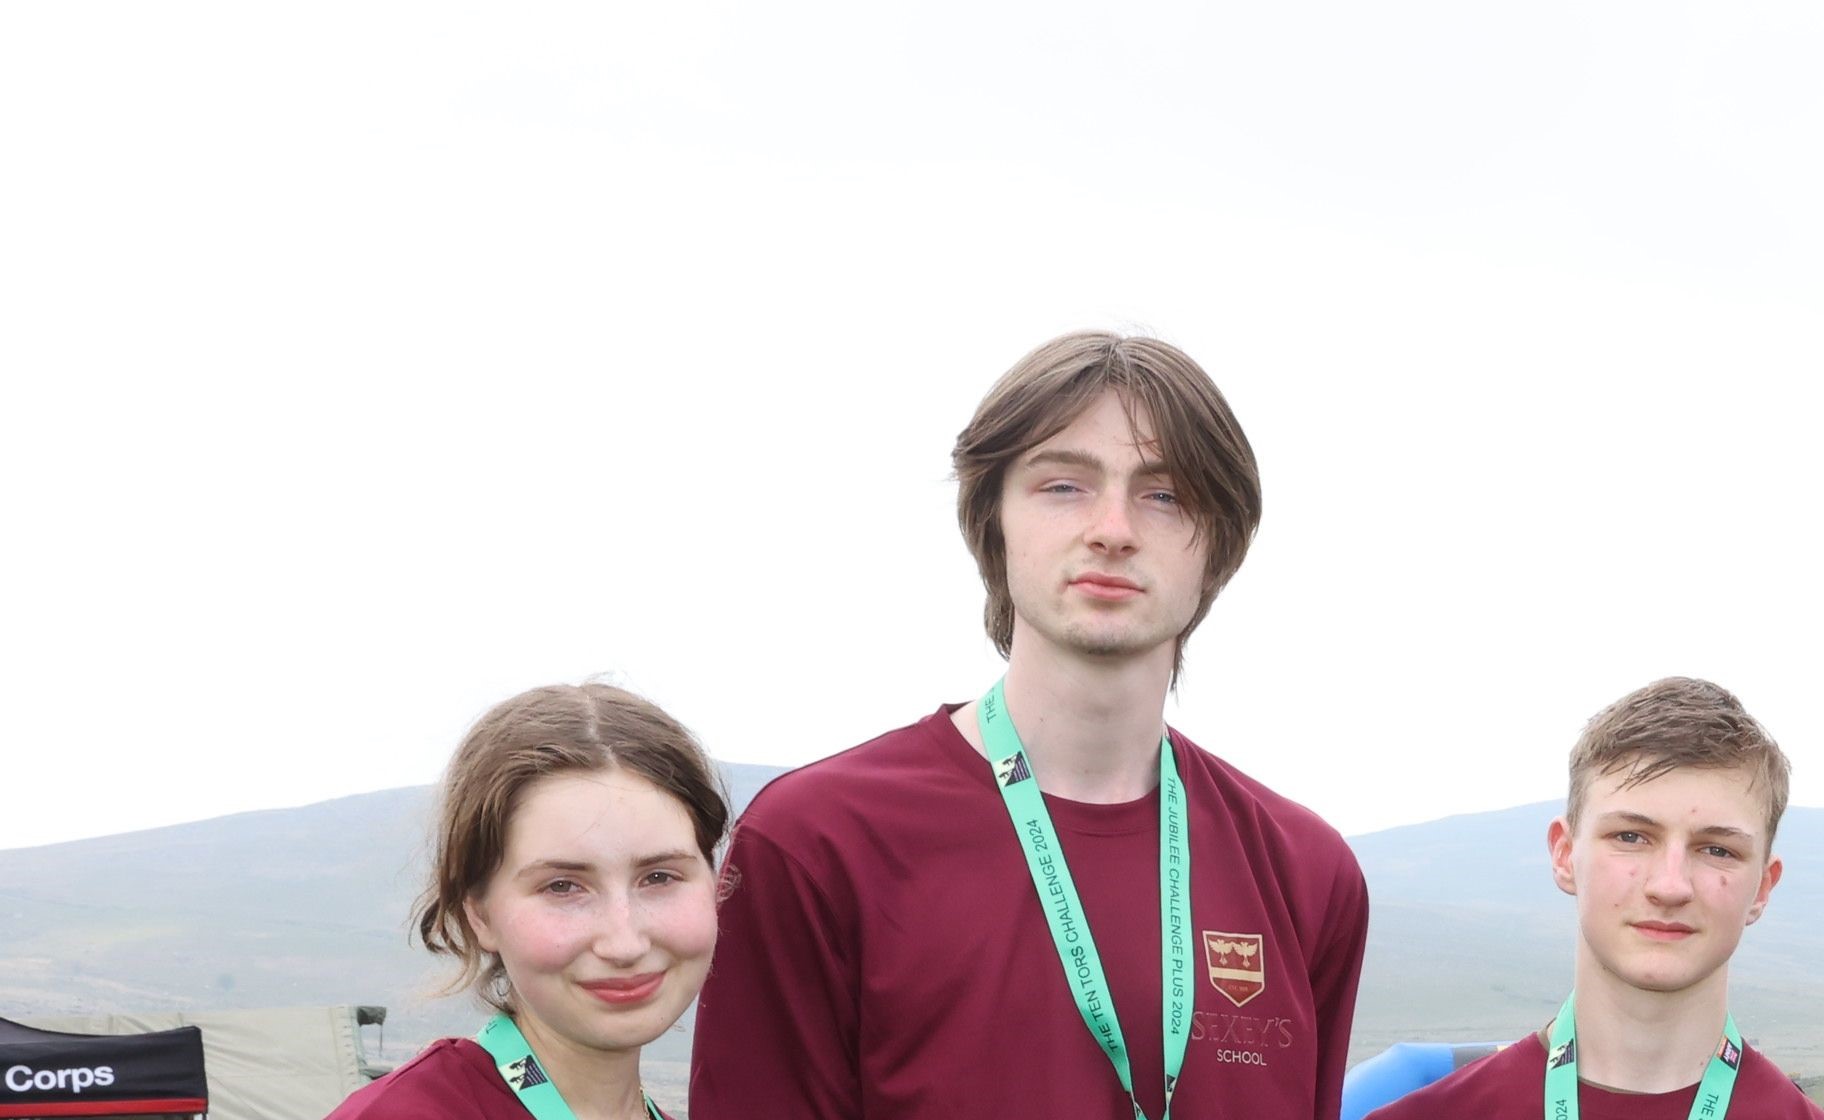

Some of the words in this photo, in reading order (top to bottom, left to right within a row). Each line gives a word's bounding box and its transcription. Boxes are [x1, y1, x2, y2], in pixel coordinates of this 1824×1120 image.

[1167, 777, 1178, 804] THE
[1026, 819, 1048, 852] 2024
[1168, 807, 1180, 865] JUBILEE
[1038, 854, 1079, 944] CHALLENGE
[1168, 867, 1183, 956] CHALLENGE
[1071, 945, 1094, 989] TORS
[1171, 959, 1184, 999] PLUS
[1085, 990, 1106, 1022] TEN
[1170, 1001, 1183, 1035] 2024
[1099, 1022, 1118, 1053] THE
[1217, 1049, 1267, 1066] SCHOOL
[5, 1065, 115, 1093] Corps
[1701, 1093, 1718, 1119] THE
